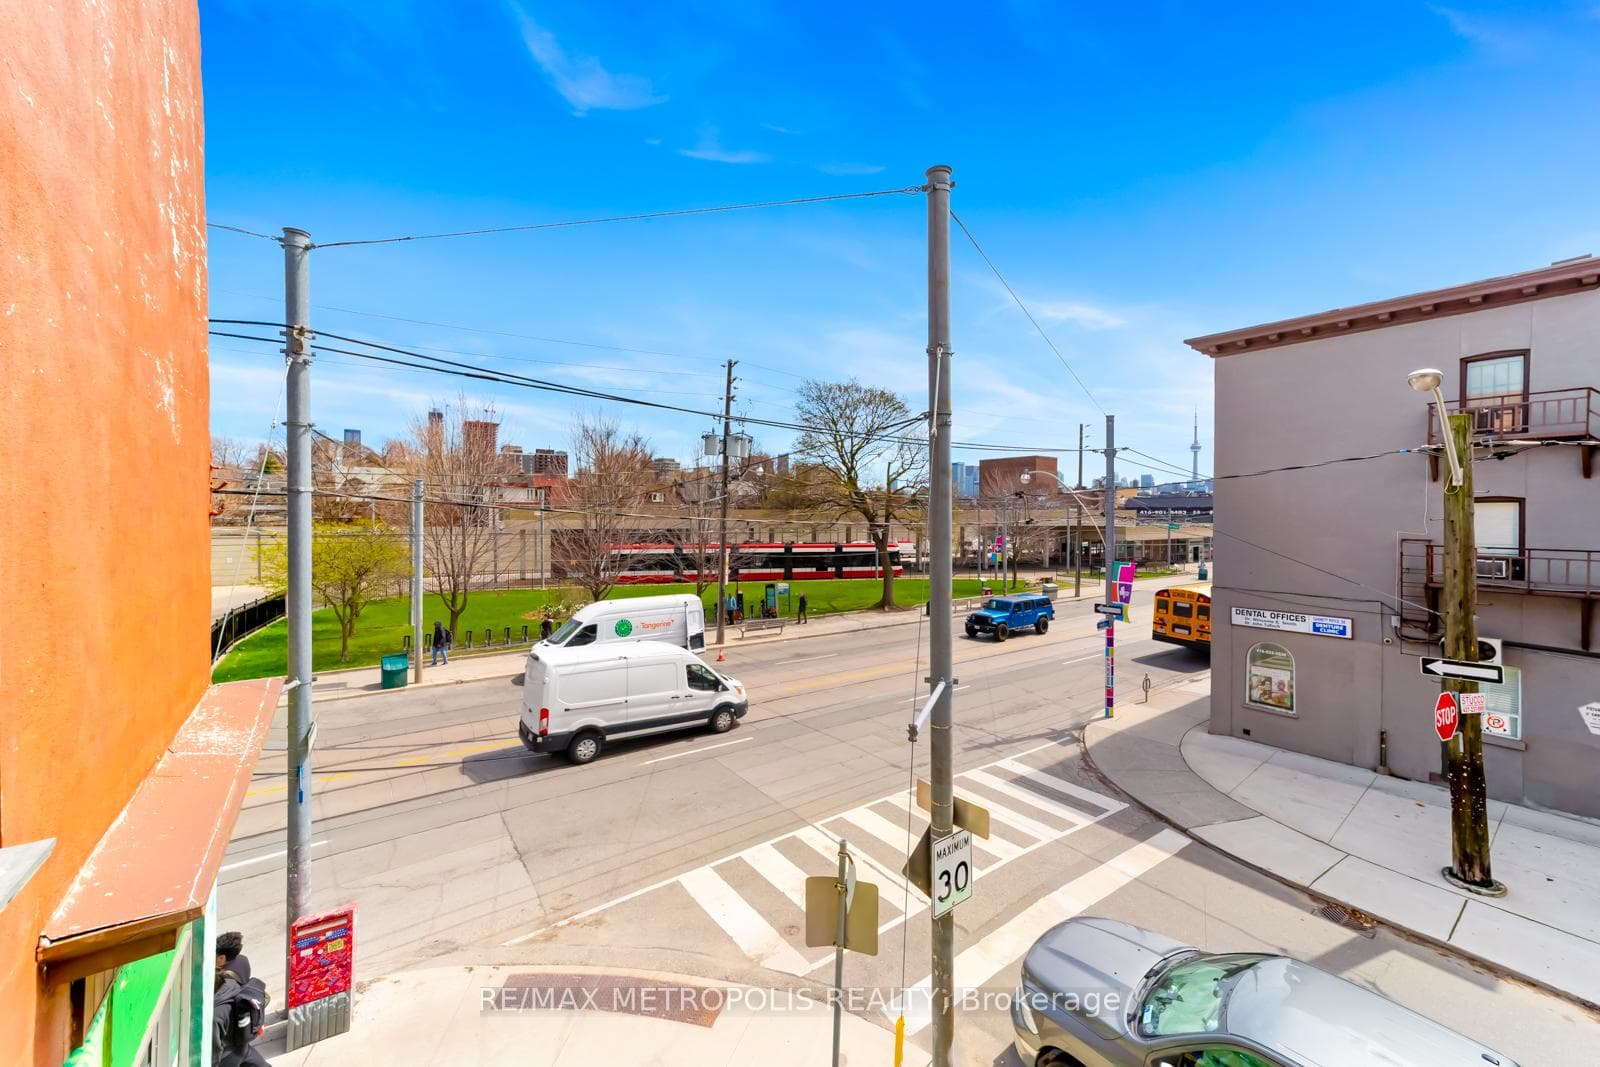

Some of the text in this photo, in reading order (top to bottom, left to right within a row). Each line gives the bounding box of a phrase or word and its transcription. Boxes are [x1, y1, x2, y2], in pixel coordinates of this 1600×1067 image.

[640, 621, 672, 630] Tangerine
[1235, 608, 1267, 619] DENTAL
[1270, 612, 1307, 623] OFFICES
[1436, 706, 1456, 727] STOP
[936, 836, 969, 859] MAXIMUM
[937, 861, 969, 903] 30
